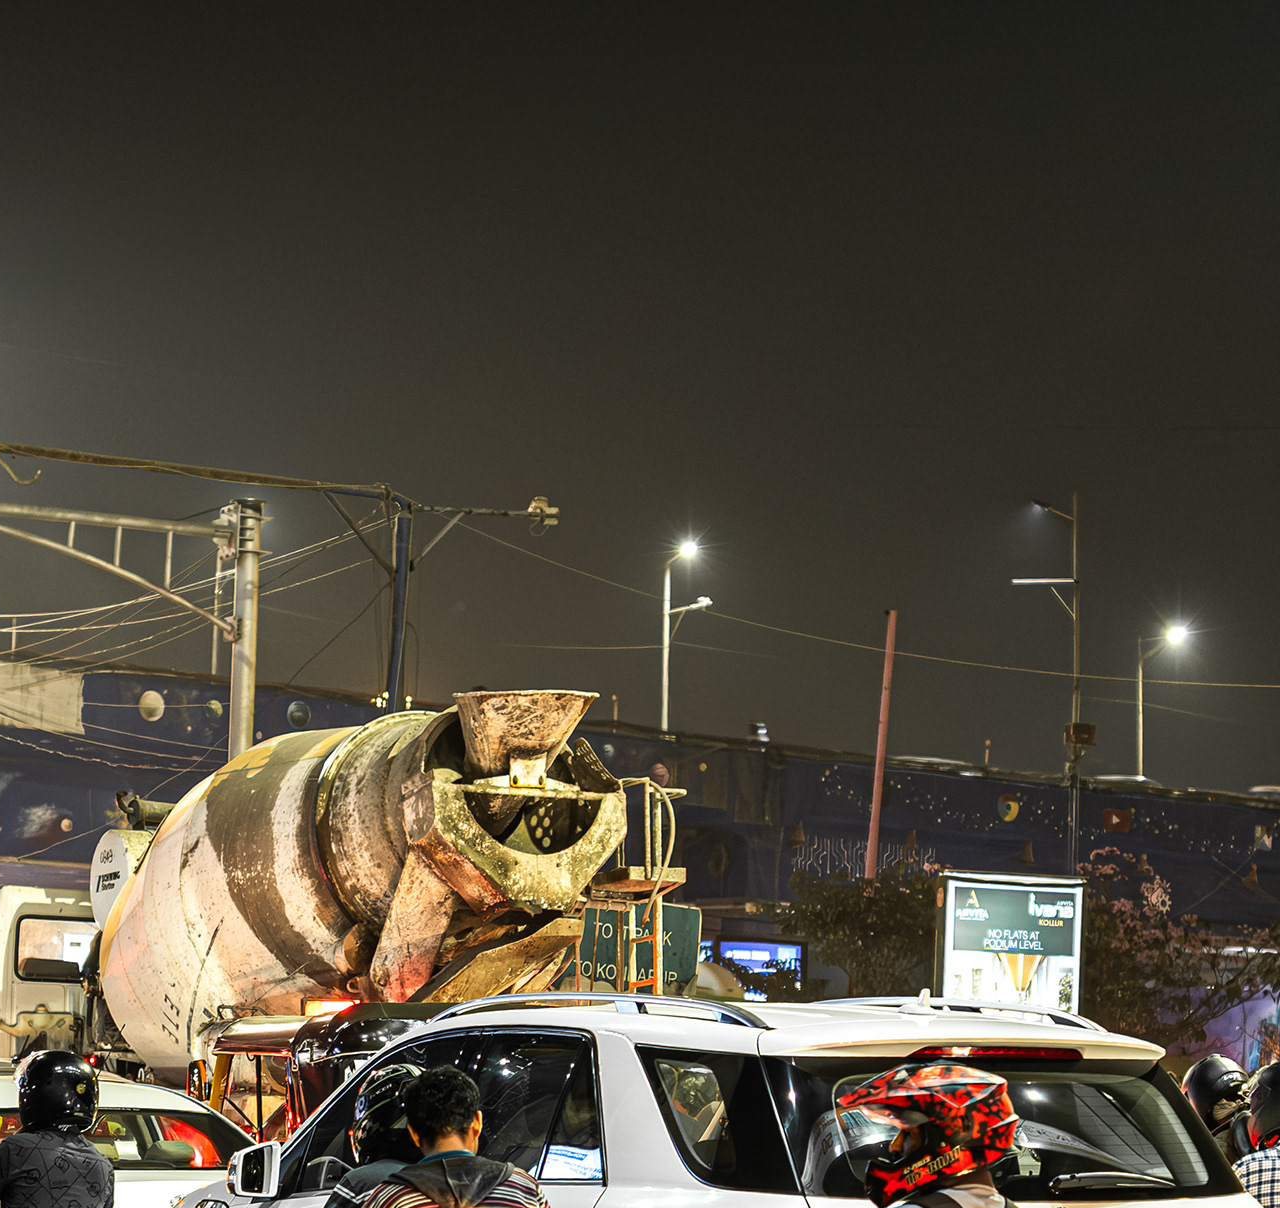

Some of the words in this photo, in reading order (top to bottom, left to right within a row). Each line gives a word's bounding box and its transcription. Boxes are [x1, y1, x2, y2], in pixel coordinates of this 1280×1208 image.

[988, 929, 1002, 939] NO
[1004, 930, 1028, 940] FLATS
[1030, 931, 1040, 940] AT
[984, 938, 1017, 949] PODIUM
[1019, 940, 1044, 951] LEVEL
